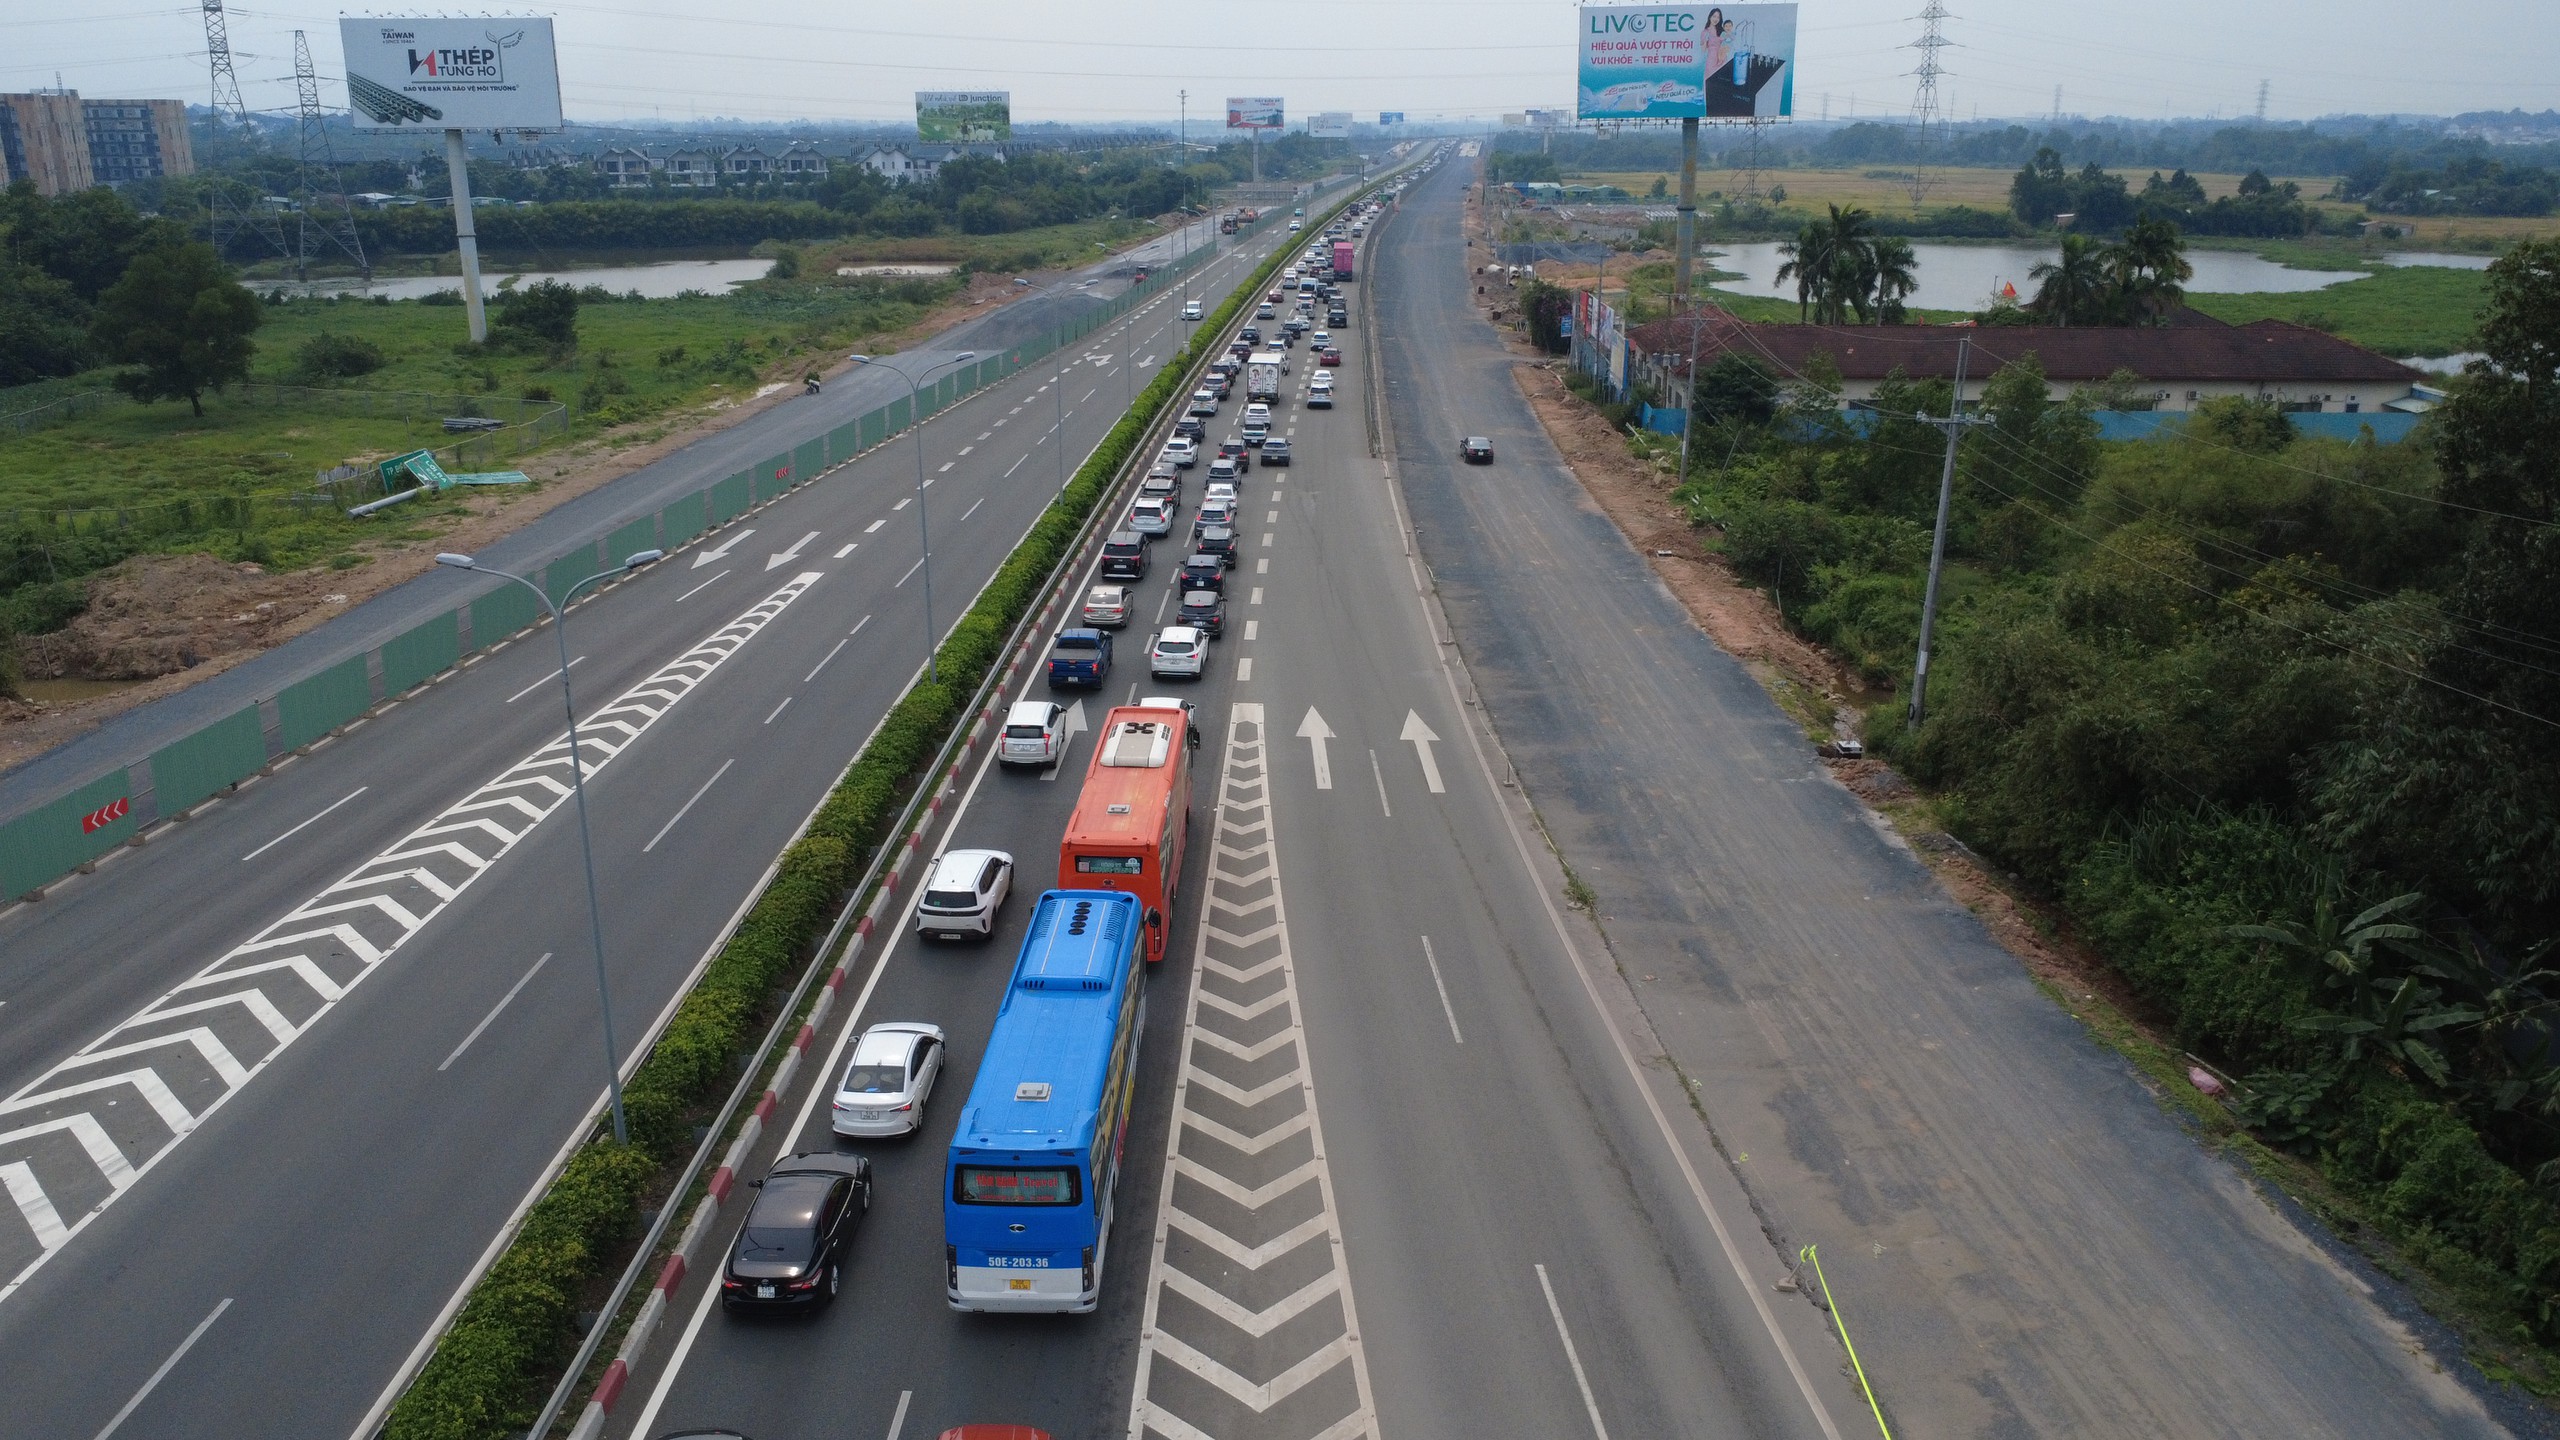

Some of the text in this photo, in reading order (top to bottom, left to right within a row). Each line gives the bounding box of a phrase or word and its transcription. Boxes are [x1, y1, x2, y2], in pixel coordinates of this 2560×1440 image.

[1591, 13, 1695, 34] LIVOTEC
[1591, 39, 1693, 53] HIỆU QUẢ VƯỢT TRỘI
[438, 46, 495, 65] THÉP
[1591, 56, 1606, 65] VUI
[1608, 54, 1632, 64] KHỎE
[1641, 53, 1659, 63] TRẺ
[1661, 55, 1693, 63] TRUNG
[438, 66, 496, 76] TUNG HO
[970, 94, 1002, 103] junction
[1023, 1175, 1058, 1188] Travel
[988, 1256, 1049, 1268] 50E-203.36
